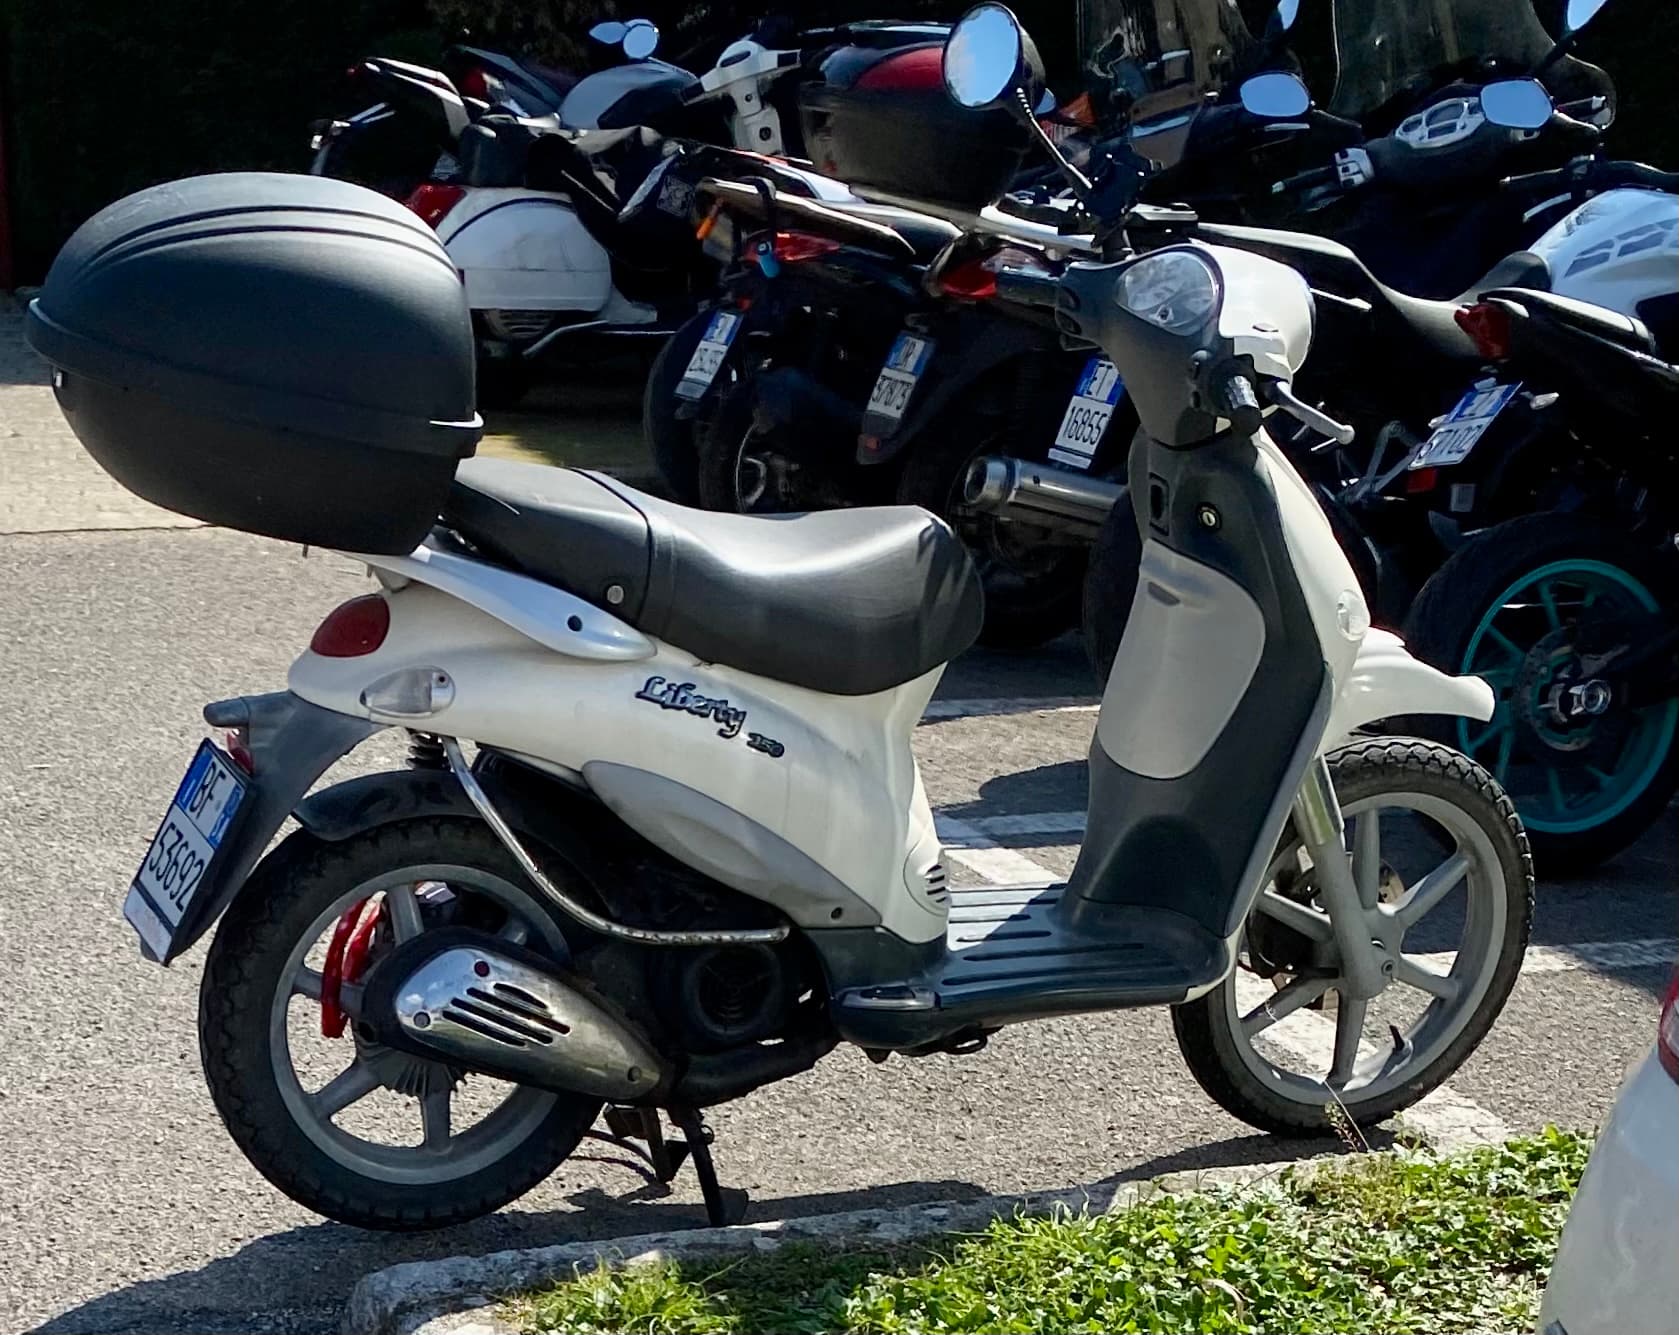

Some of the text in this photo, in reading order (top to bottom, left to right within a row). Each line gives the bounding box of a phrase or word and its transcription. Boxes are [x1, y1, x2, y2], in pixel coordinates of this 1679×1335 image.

[1085, 363, 1113, 397] ET
[1063, 406, 1108, 445] 16855
[634, 675, 747, 739] Liberty
[189, 761, 227, 820] BF
[149, 822, 206, 912] 53692
